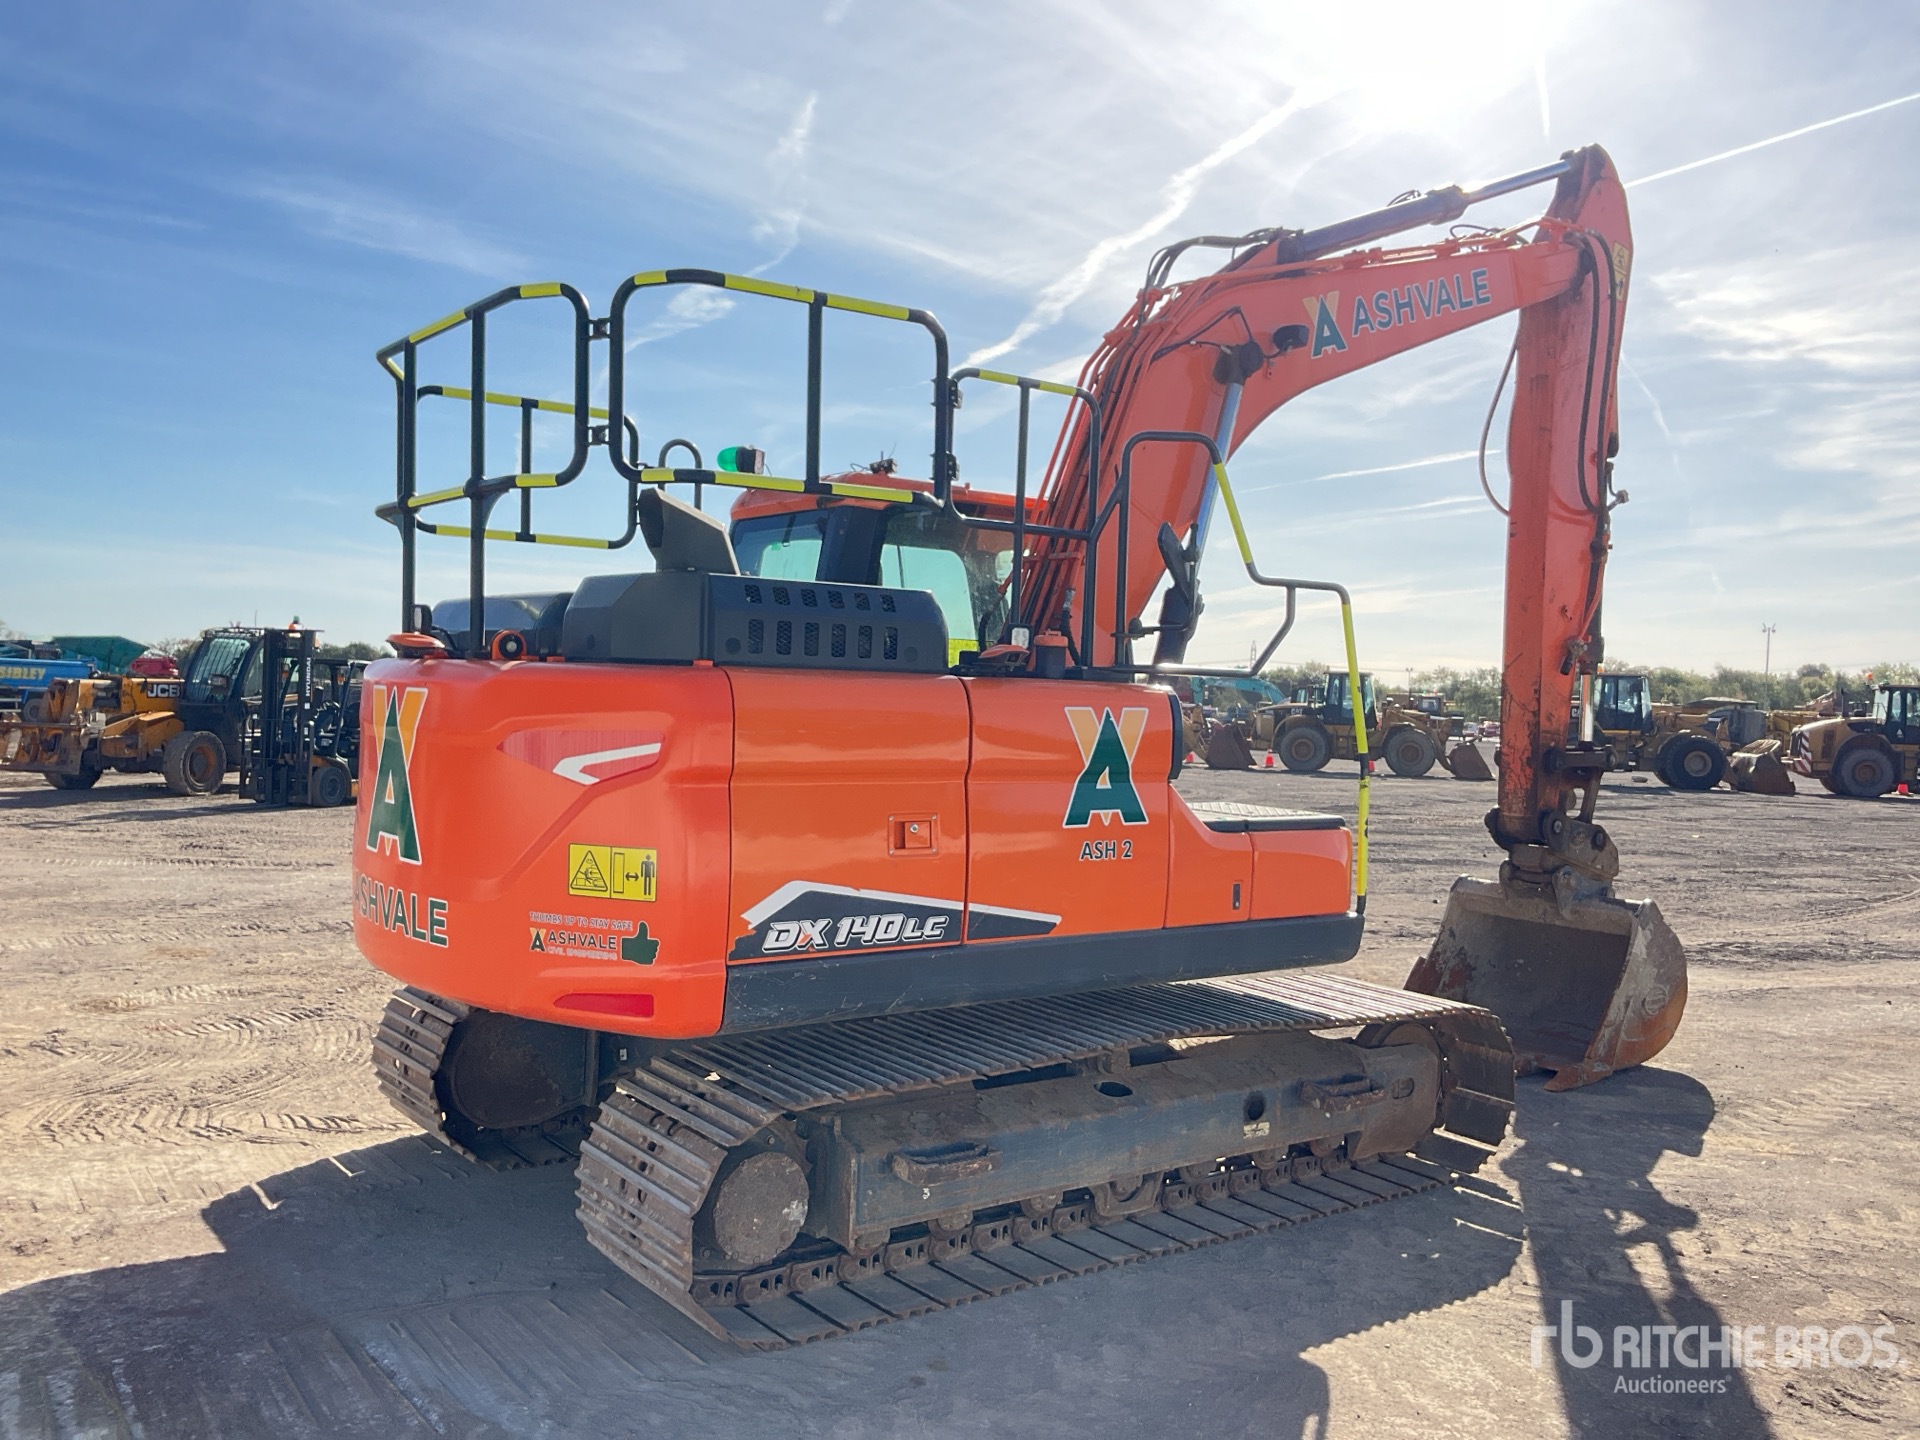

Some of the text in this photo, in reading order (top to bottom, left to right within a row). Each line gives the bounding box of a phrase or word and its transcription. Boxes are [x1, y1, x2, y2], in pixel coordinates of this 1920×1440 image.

[1352, 268, 1491, 336] ASHVALE
[148, 684, 180, 698] JCB
[1080, 839, 1134, 862] ASH 2
[529, 911, 633, 931] THUMBS UP TO STAY SAFE
[548, 930, 617, 950] ASHVALE
[762, 917, 832, 954] DX
